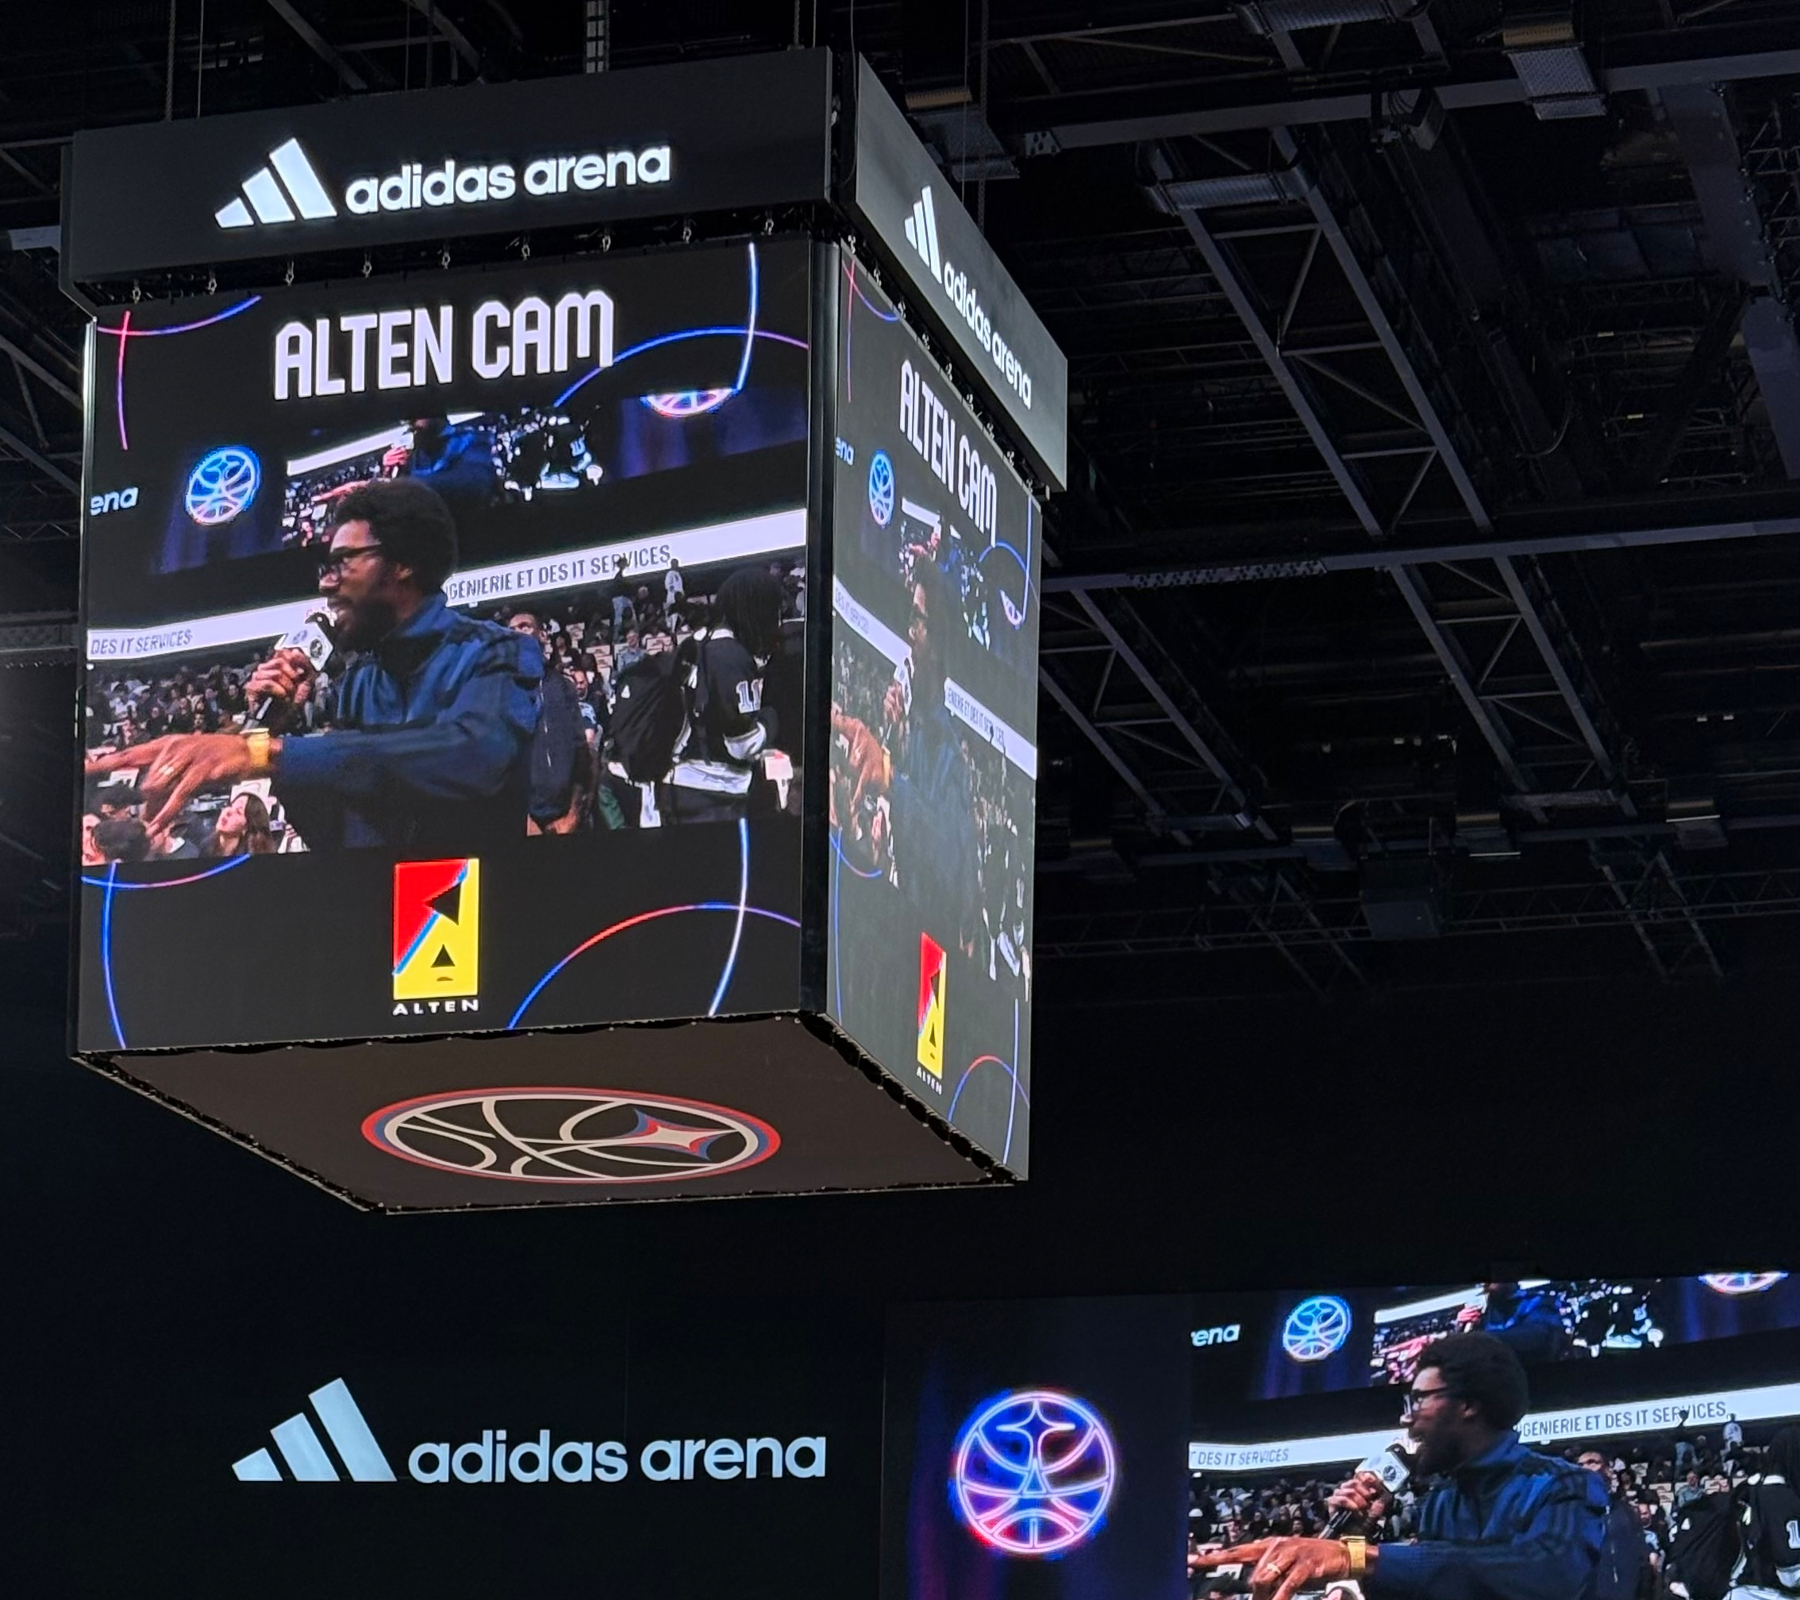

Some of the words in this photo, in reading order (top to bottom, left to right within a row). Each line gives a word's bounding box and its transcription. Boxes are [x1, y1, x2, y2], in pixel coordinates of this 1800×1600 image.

[345, 159, 516, 215] adidas
[523, 146, 671, 196] arena
[274, 305, 453, 400] ALTEN
[471, 290, 614, 377] CAM
[943, 261, 993, 353] adidas
[992, 331, 1032, 410] arena
[900, 359, 954, 494] ALTEN
[957, 434, 998, 548] CAM
[446, 575, 512, 600] GENIERIE
[517, 569, 534, 588] ET
[539, 563, 568, 583] DES
[572, 560, 585, 578] IT
[91, 637, 117, 655] DES
[121, 635, 134, 653] IT
[136, 628, 193, 652] SERVICES
[392, 999, 479, 1015] ALTEN
[1191, 1324, 1241, 1347] ena
[1519, 1418, 1582, 1437] GENIERIE
[1585, 1416, 1600, 1430] ET
[1605, 1410, 1632, 1429] DES
[1636, 1409, 1649, 1425] IT
[408, 1429, 629, 1484] adidas
[640, 1436, 827, 1482] arena
[1198, 1451, 1223, 1465] DES
[1224, 1452, 1237, 1465] IT
